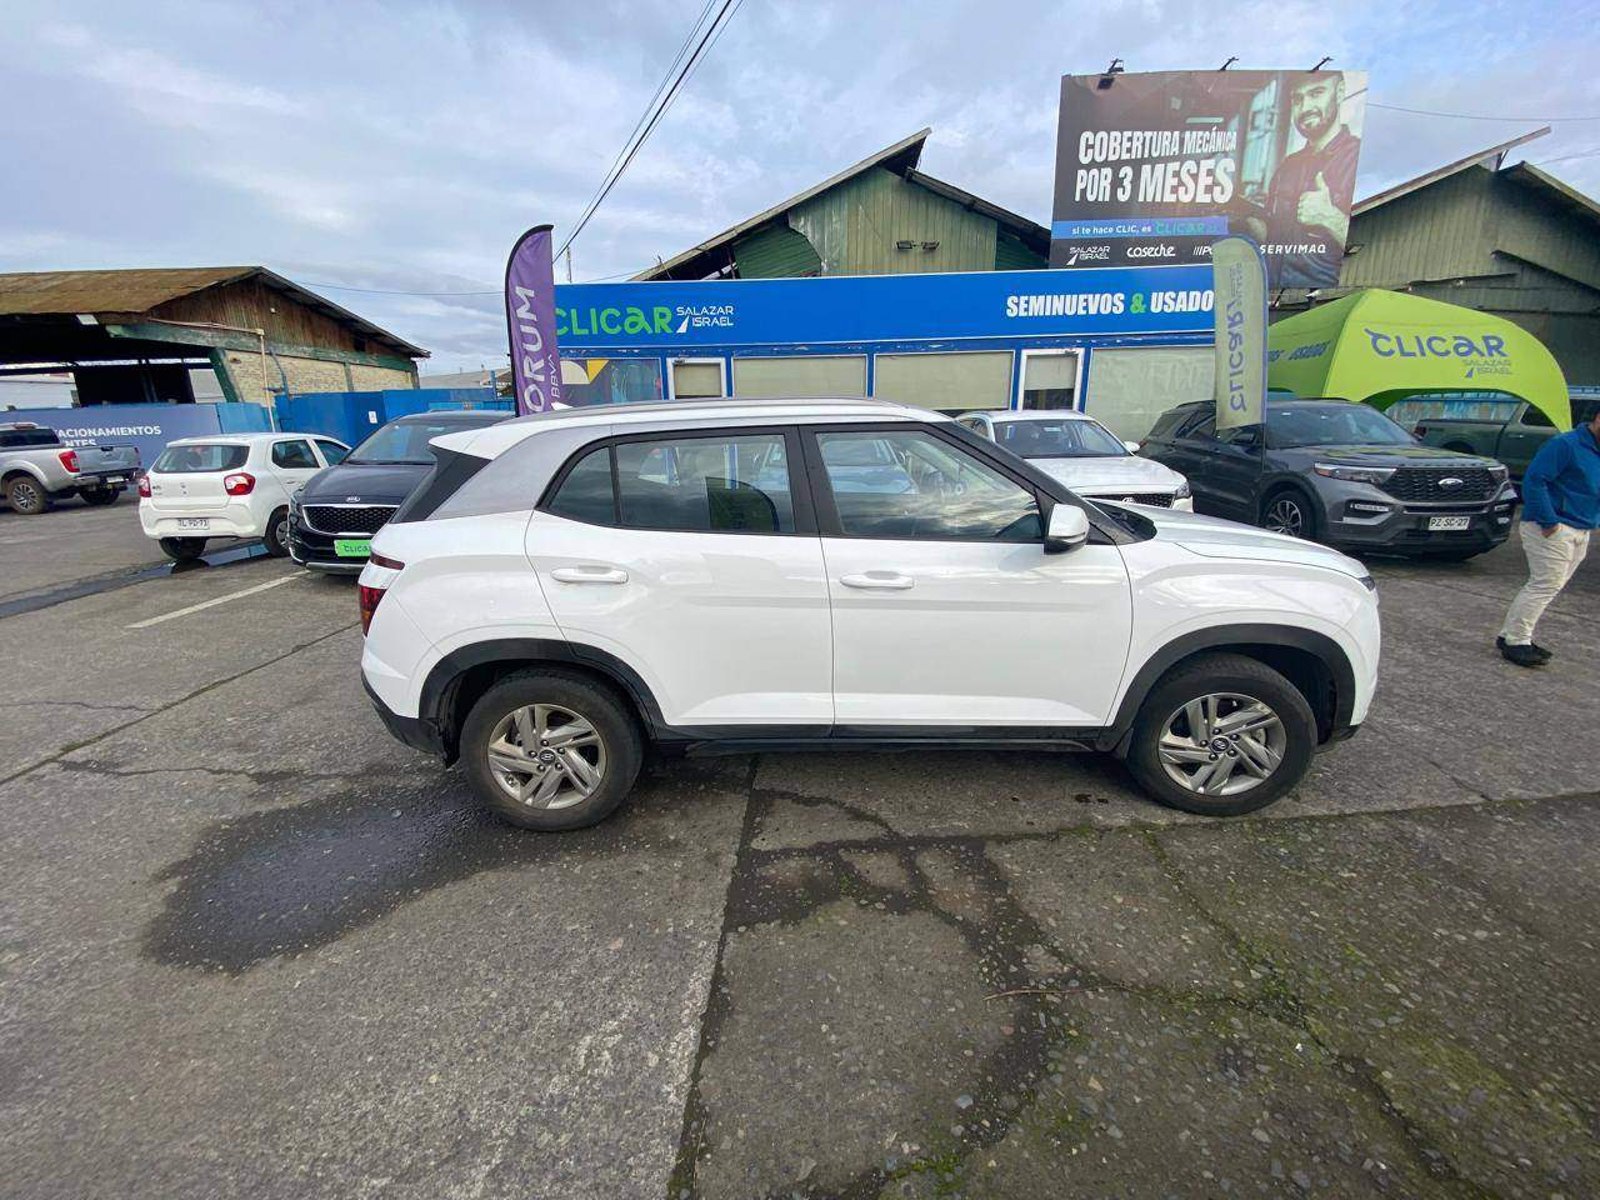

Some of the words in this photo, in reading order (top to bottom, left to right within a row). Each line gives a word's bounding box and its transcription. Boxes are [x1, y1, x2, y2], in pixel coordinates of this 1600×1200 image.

[1078, 131, 1181, 164] COBERTURA
[1183, 126, 1237, 154] MECÁNICA
[1075, 167, 1112, 202] POR
[1116, 166, 1133, 202] 3
[1138, 158, 1236, 204] MESES
[1093, 226, 1114, 235] hace
[1069, 246, 1111, 255] SALAZAR
[1259, 243, 1326, 255] SERVIMAQ
[676, 305, 734, 316] SALAZAR
[1006, 292, 1125, 317] SEMINUEVOS
[1129, 293, 1146, 314] &
[692, 316, 735, 327] ISRAEL
[547, 353, 561, 399] BBVA
